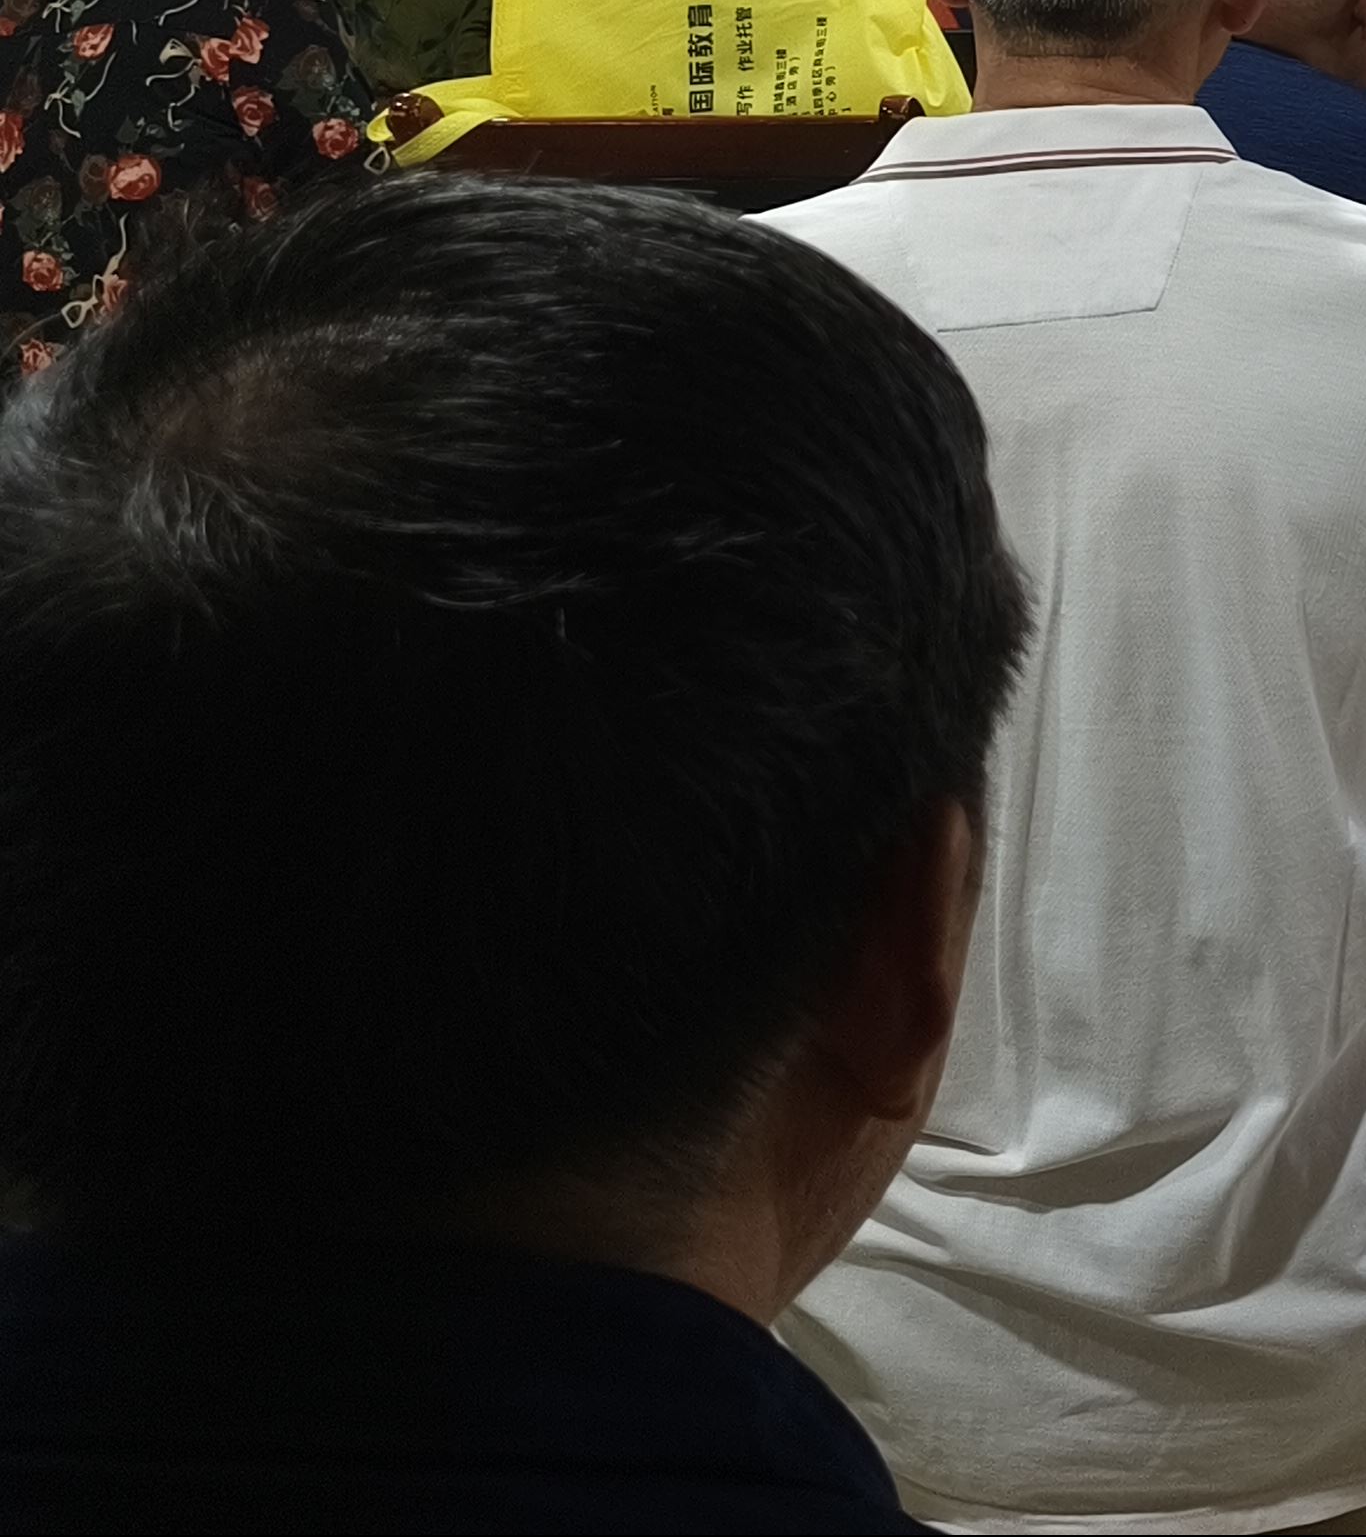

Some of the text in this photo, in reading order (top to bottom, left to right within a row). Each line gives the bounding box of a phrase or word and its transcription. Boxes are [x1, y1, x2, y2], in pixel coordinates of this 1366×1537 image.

[687, 4, 714, 115] 国际教育
[735, 6, 754, 72] 作业托管
